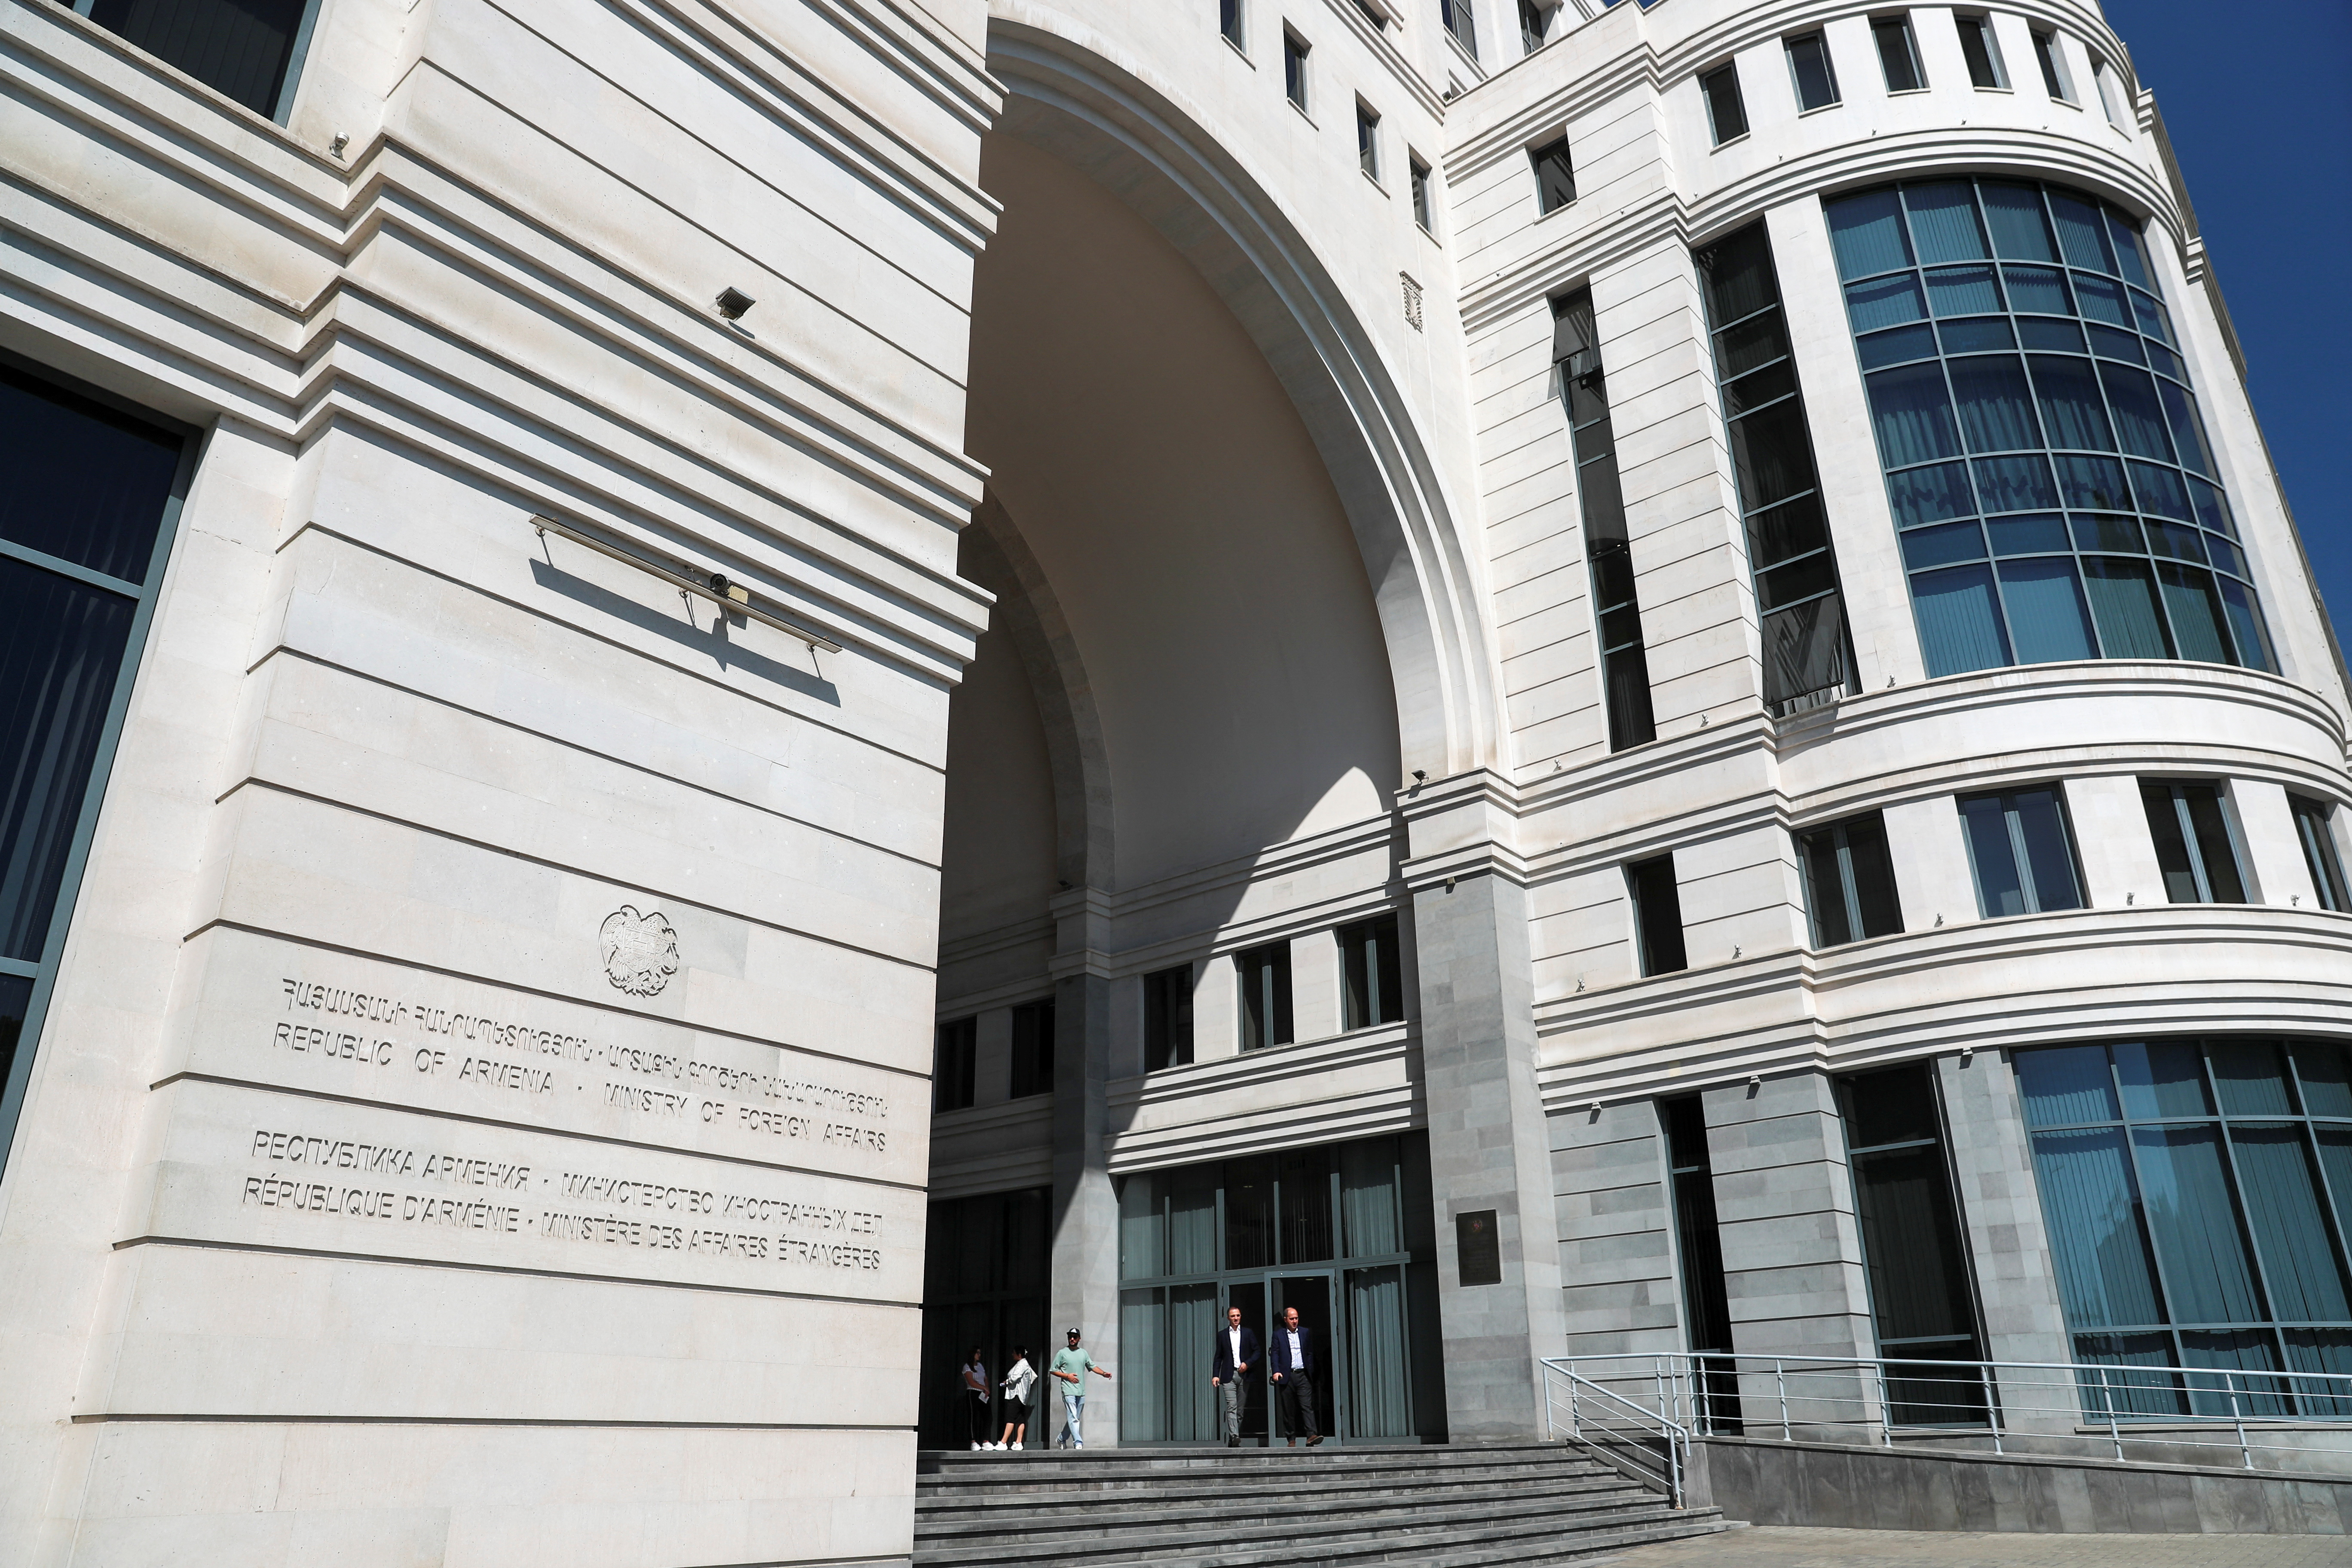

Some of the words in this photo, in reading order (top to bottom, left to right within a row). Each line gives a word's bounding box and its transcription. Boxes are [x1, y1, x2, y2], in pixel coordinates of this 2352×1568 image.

[273, 1022, 392, 1066] REPUBLIC
[415, 1049, 446, 1074] OF
[459, 1057, 554, 1096] ARMENIA
[603, 1083, 688, 1117] MINISTRY
[701, 1101, 725, 1124] OF
[738, 1107, 810, 1140] FOREIGN
[823, 1123, 886, 1152] AFFAIRS
[282, 978, 407, 1026] ՀԱՅԱՍՏԱՆԻ
[415, 1006, 593, 1062] ՀԱՆՐԱՊԵՏՈՒԹՅՈՒՆ
[608, 1045, 682, 1079] ԱՐՏԱՔԻՆ
[689, 1061, 758, 1093] ԳՈՐԾԵՐԻ
[763, 1075, 888, 1118] ՆԱԽԱՐԱՐՈՒԹՅՈՒՆ
[243, 1173, 395, 1218] RÉPUBLIQUE
[403, 1195, 520, 1233] D'ARMÉNIE
[541, 1212, 642, 1246] MINISTÈRE
[648, 1225, 683, 1250] DES
[688, 1230, 768, 1259] AFFAIRES
[778, 1234, 881, 1271] ÉTRANGÈRES
[252, 1130, 415, 1177] РЕСПУБЛИКА
[422, 1155, 530, 1191] АРМЕНИЯ
[561, 1173, 714, 1214] МИНИСТЕРСТВО
[723, 1194, 847, 1231] ИНОСТРАННЫХ
[851, 1212, 883, 1237] ДЕЛ
